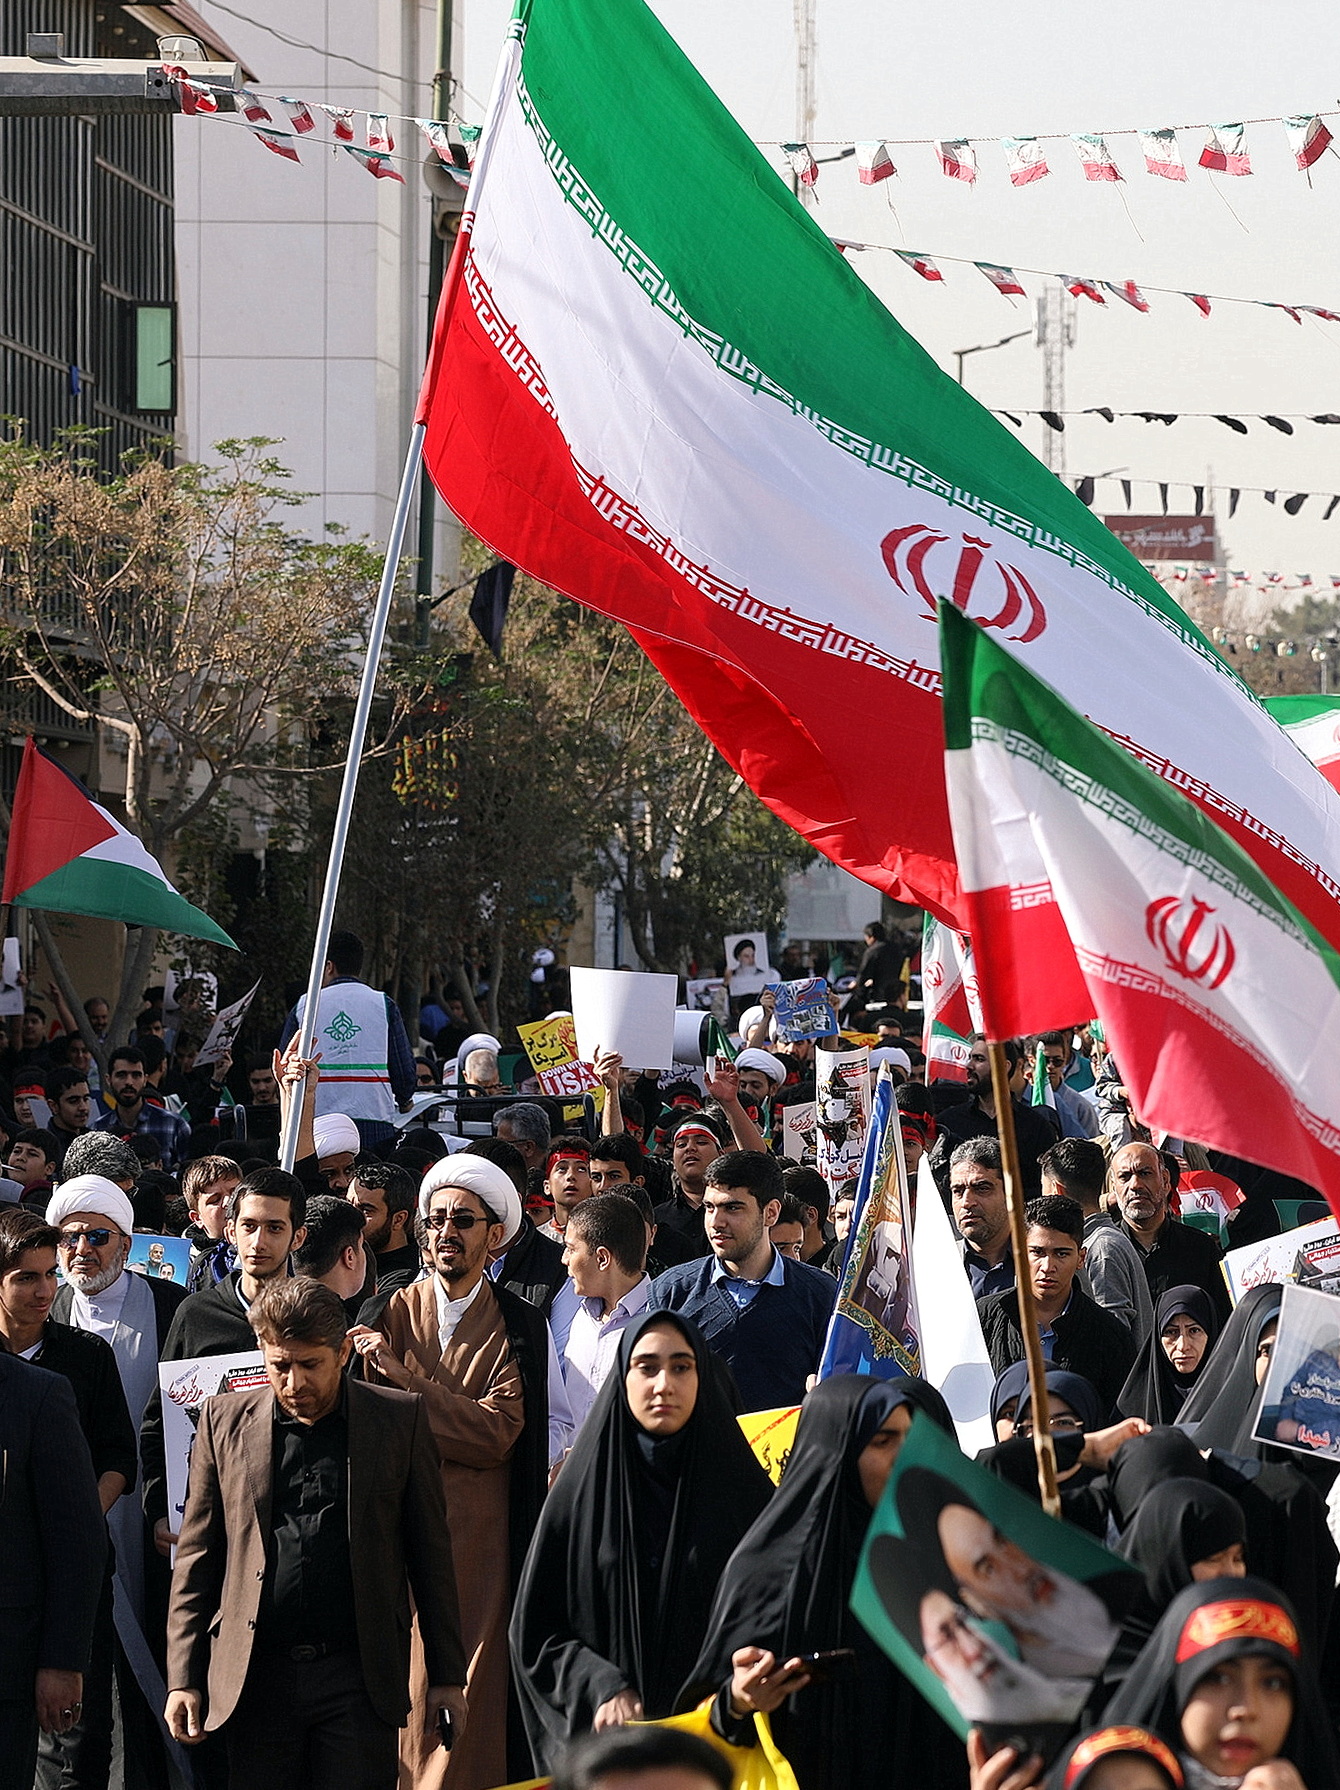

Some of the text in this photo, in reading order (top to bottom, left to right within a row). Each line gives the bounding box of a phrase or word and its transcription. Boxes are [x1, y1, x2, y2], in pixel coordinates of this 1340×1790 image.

[526, 1037, 537, 1053] بر
[541, 1063, 567, 1080] DOWN
[543, 1066, 600, 1096] USA
